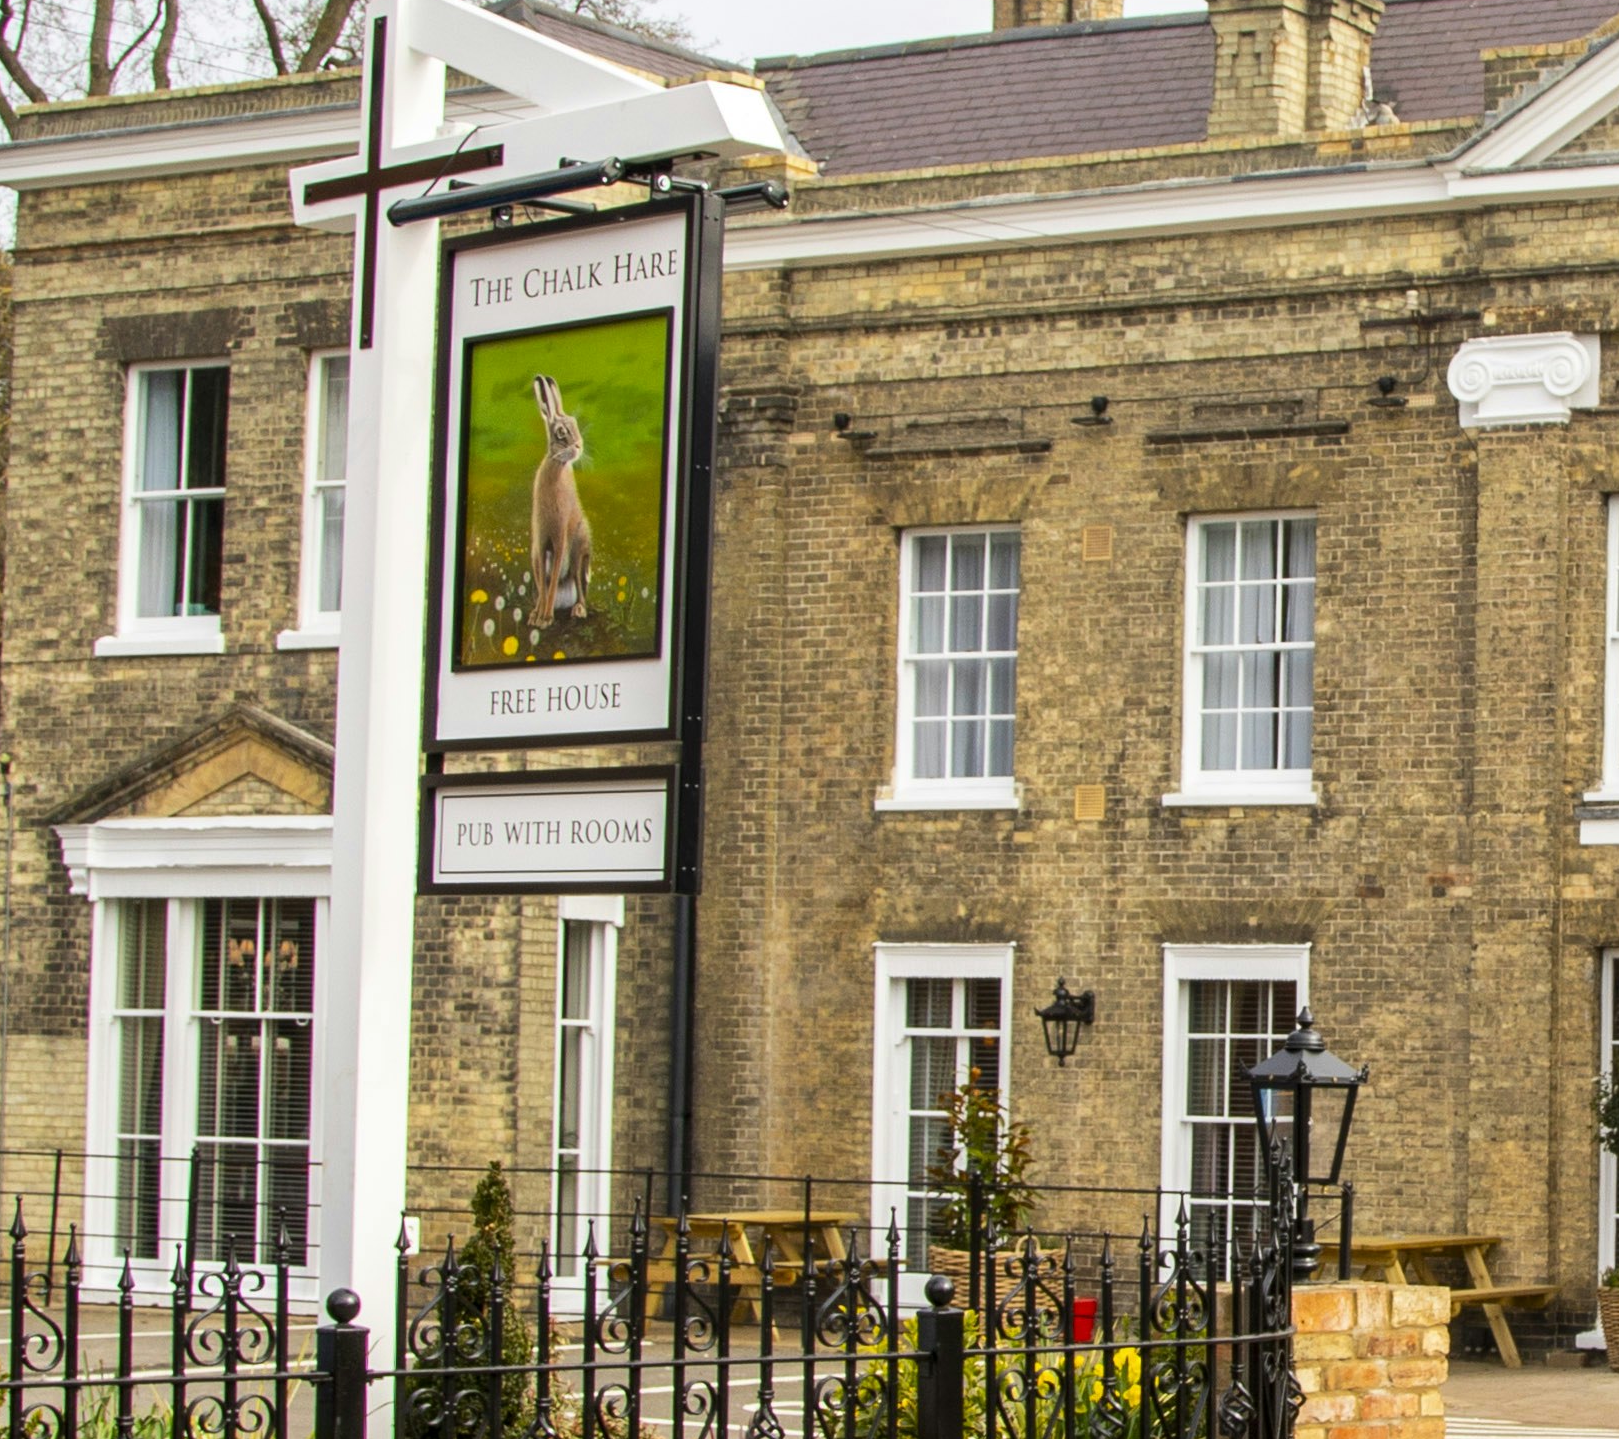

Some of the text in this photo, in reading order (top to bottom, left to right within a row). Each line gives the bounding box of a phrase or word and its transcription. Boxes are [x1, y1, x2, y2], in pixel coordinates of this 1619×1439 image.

[470, 249, 677, 306] THE CHALK HARE
[490, 683, 621, 715] FREE HOUSE
[457, 818, 653, 846] PUB WITH ROOMS
